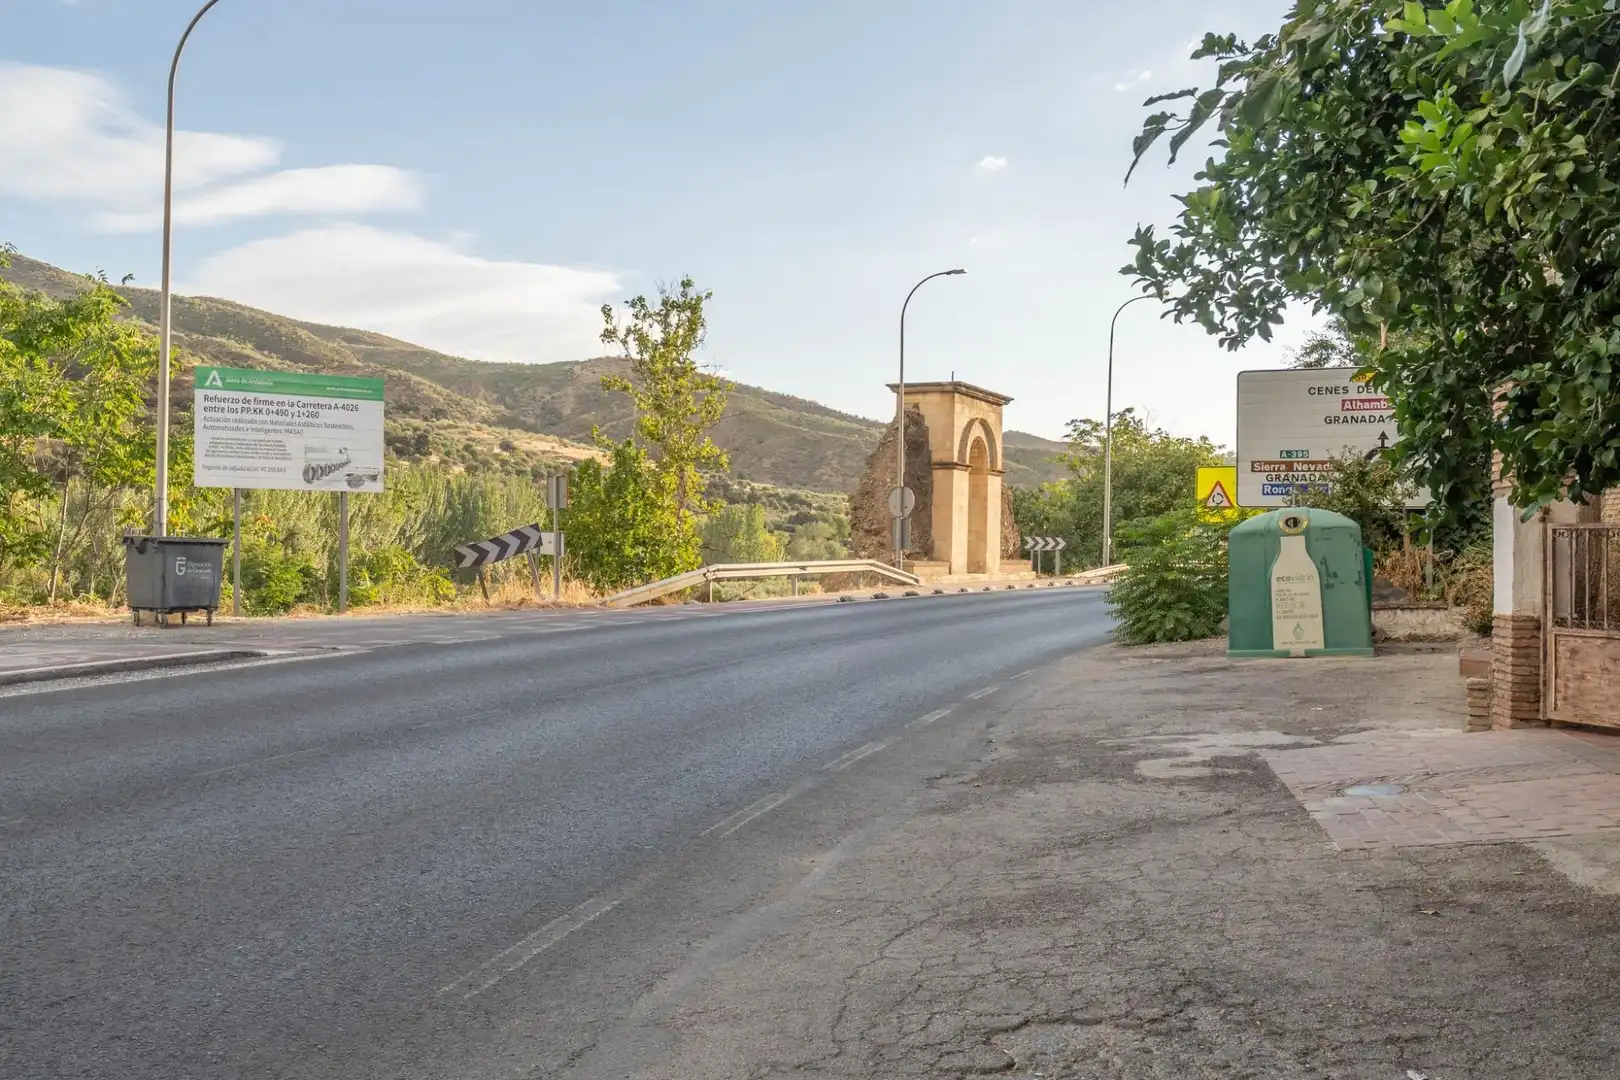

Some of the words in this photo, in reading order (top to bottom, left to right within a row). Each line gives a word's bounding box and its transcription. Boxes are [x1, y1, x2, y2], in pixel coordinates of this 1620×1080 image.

[1308, 386, 1349, 396] CENES
[1357, 385, 1373, 394] DE
[203, 394, 240, 404] Refuerzo
[241, 396, 252, 405] de
[253, 397, 275, 407] firme
[288, 399, 295, 408] la
[296, 400, 332, 410] Carretera
[333, 403, 359, 412] A-4026
[1343, 400, 1391, 411] Alhamb
[203, 405, 226, 413] entre
[227, 406, 239, 414] los
[240, 407, 264, 416] PP.KK
[265, 408, 289, 418] 0+490
[290, 411, 296, 419] y
[297, 410, 320, 419] 1+260
[203, 415, 231, 423] Actuación
[269, 418, 296, 427] Materiales
[1324, 415, 1385, 425] GRANADA
[203, 424, 245, 433] Automatizados
[1253, 462, 1286, 472] Sierra
